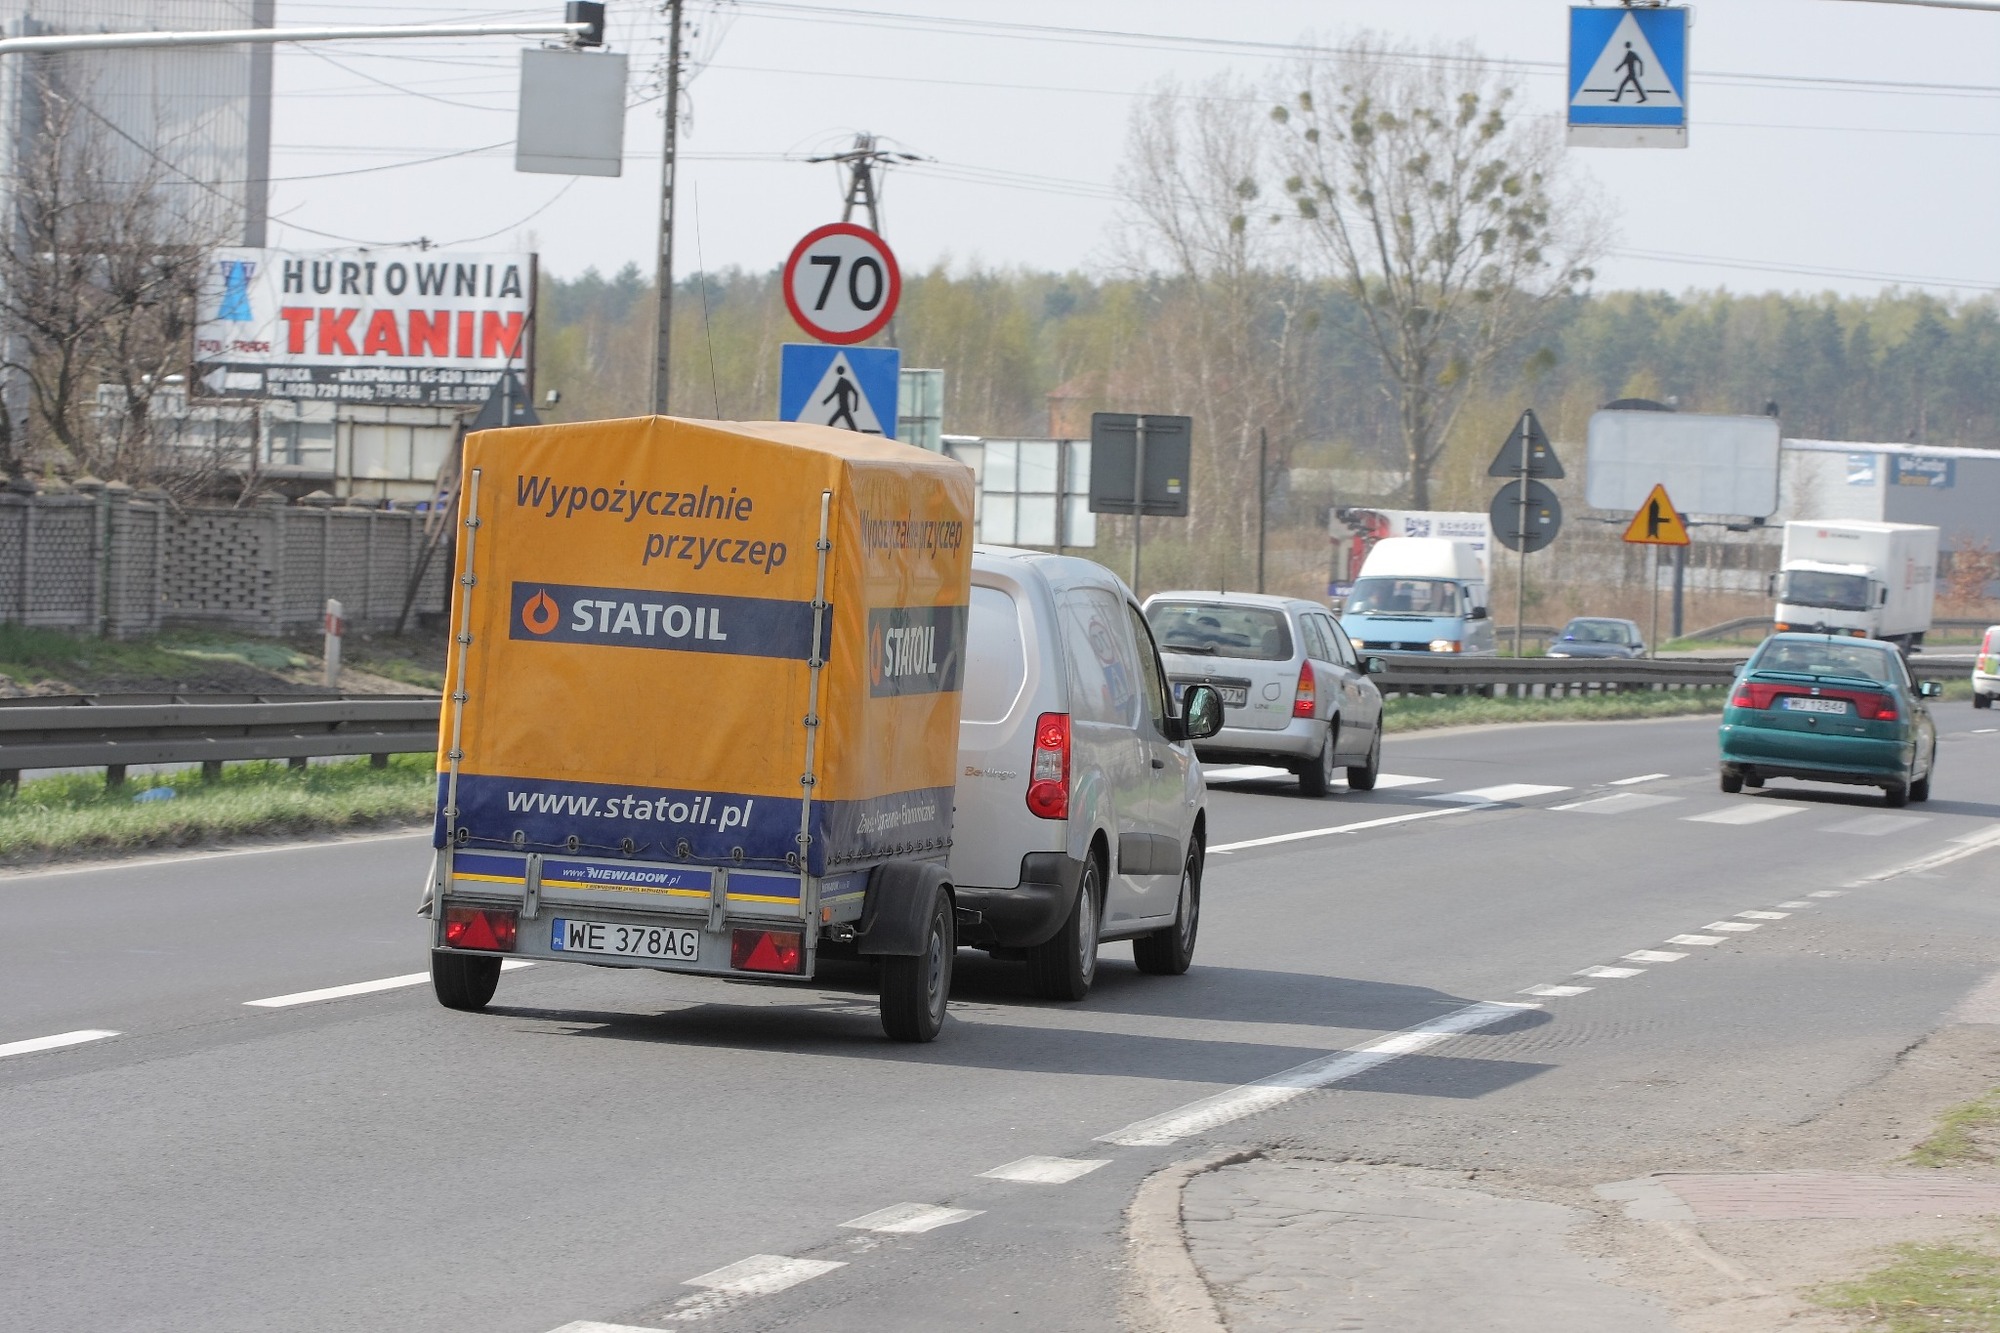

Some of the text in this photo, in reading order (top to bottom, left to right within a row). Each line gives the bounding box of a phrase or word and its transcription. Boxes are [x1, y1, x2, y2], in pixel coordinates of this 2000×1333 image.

[283, 259, 524, 299] HURTOWNIA
[810, 255, 883, 311] 70
[281, 306, 525, 359] TKANIN
[517, 475, 754, 522] Wypożyczalnie
[642, 531, 787, 574] przyczep
[918, 519, 963, 560] przyczep
[571, 599, 727, 641] STATOIL
[884, 625, 937, 677] STATOIL
[965, 766, 1017, 780] Berlingo
[507, 790, 754, 833] www.statoil.pl
[553, 923, 695, 956] PL WE 378AG
